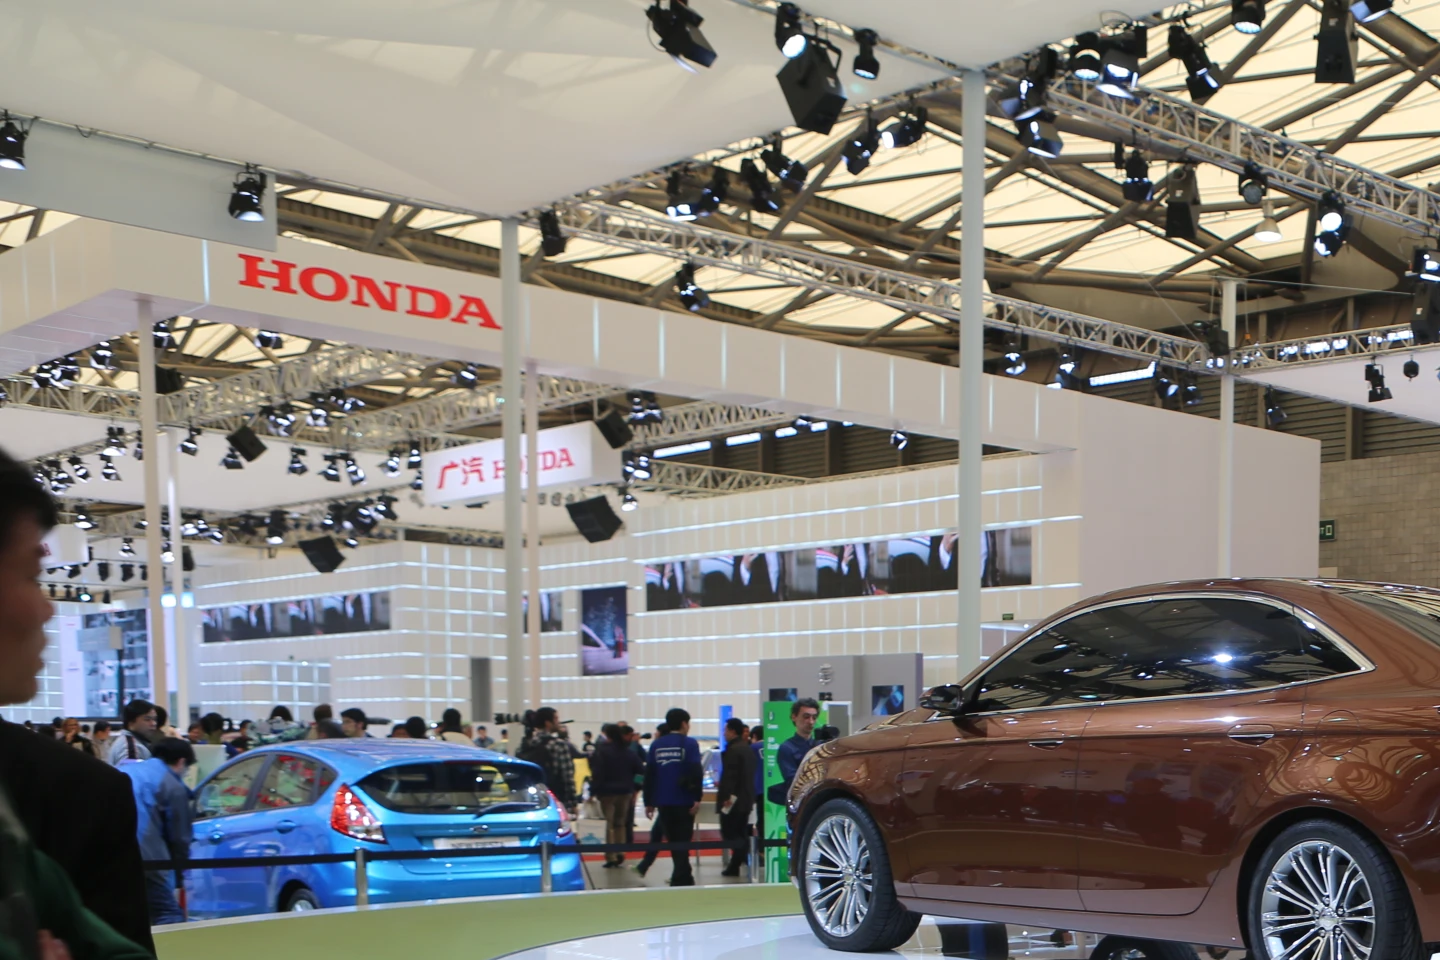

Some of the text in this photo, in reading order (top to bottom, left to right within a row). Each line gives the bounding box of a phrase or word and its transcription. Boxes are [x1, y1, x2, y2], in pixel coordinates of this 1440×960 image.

[238, 253, 502, 330] HONDA
[437, 448, 574, 489] 广汽 HDA
